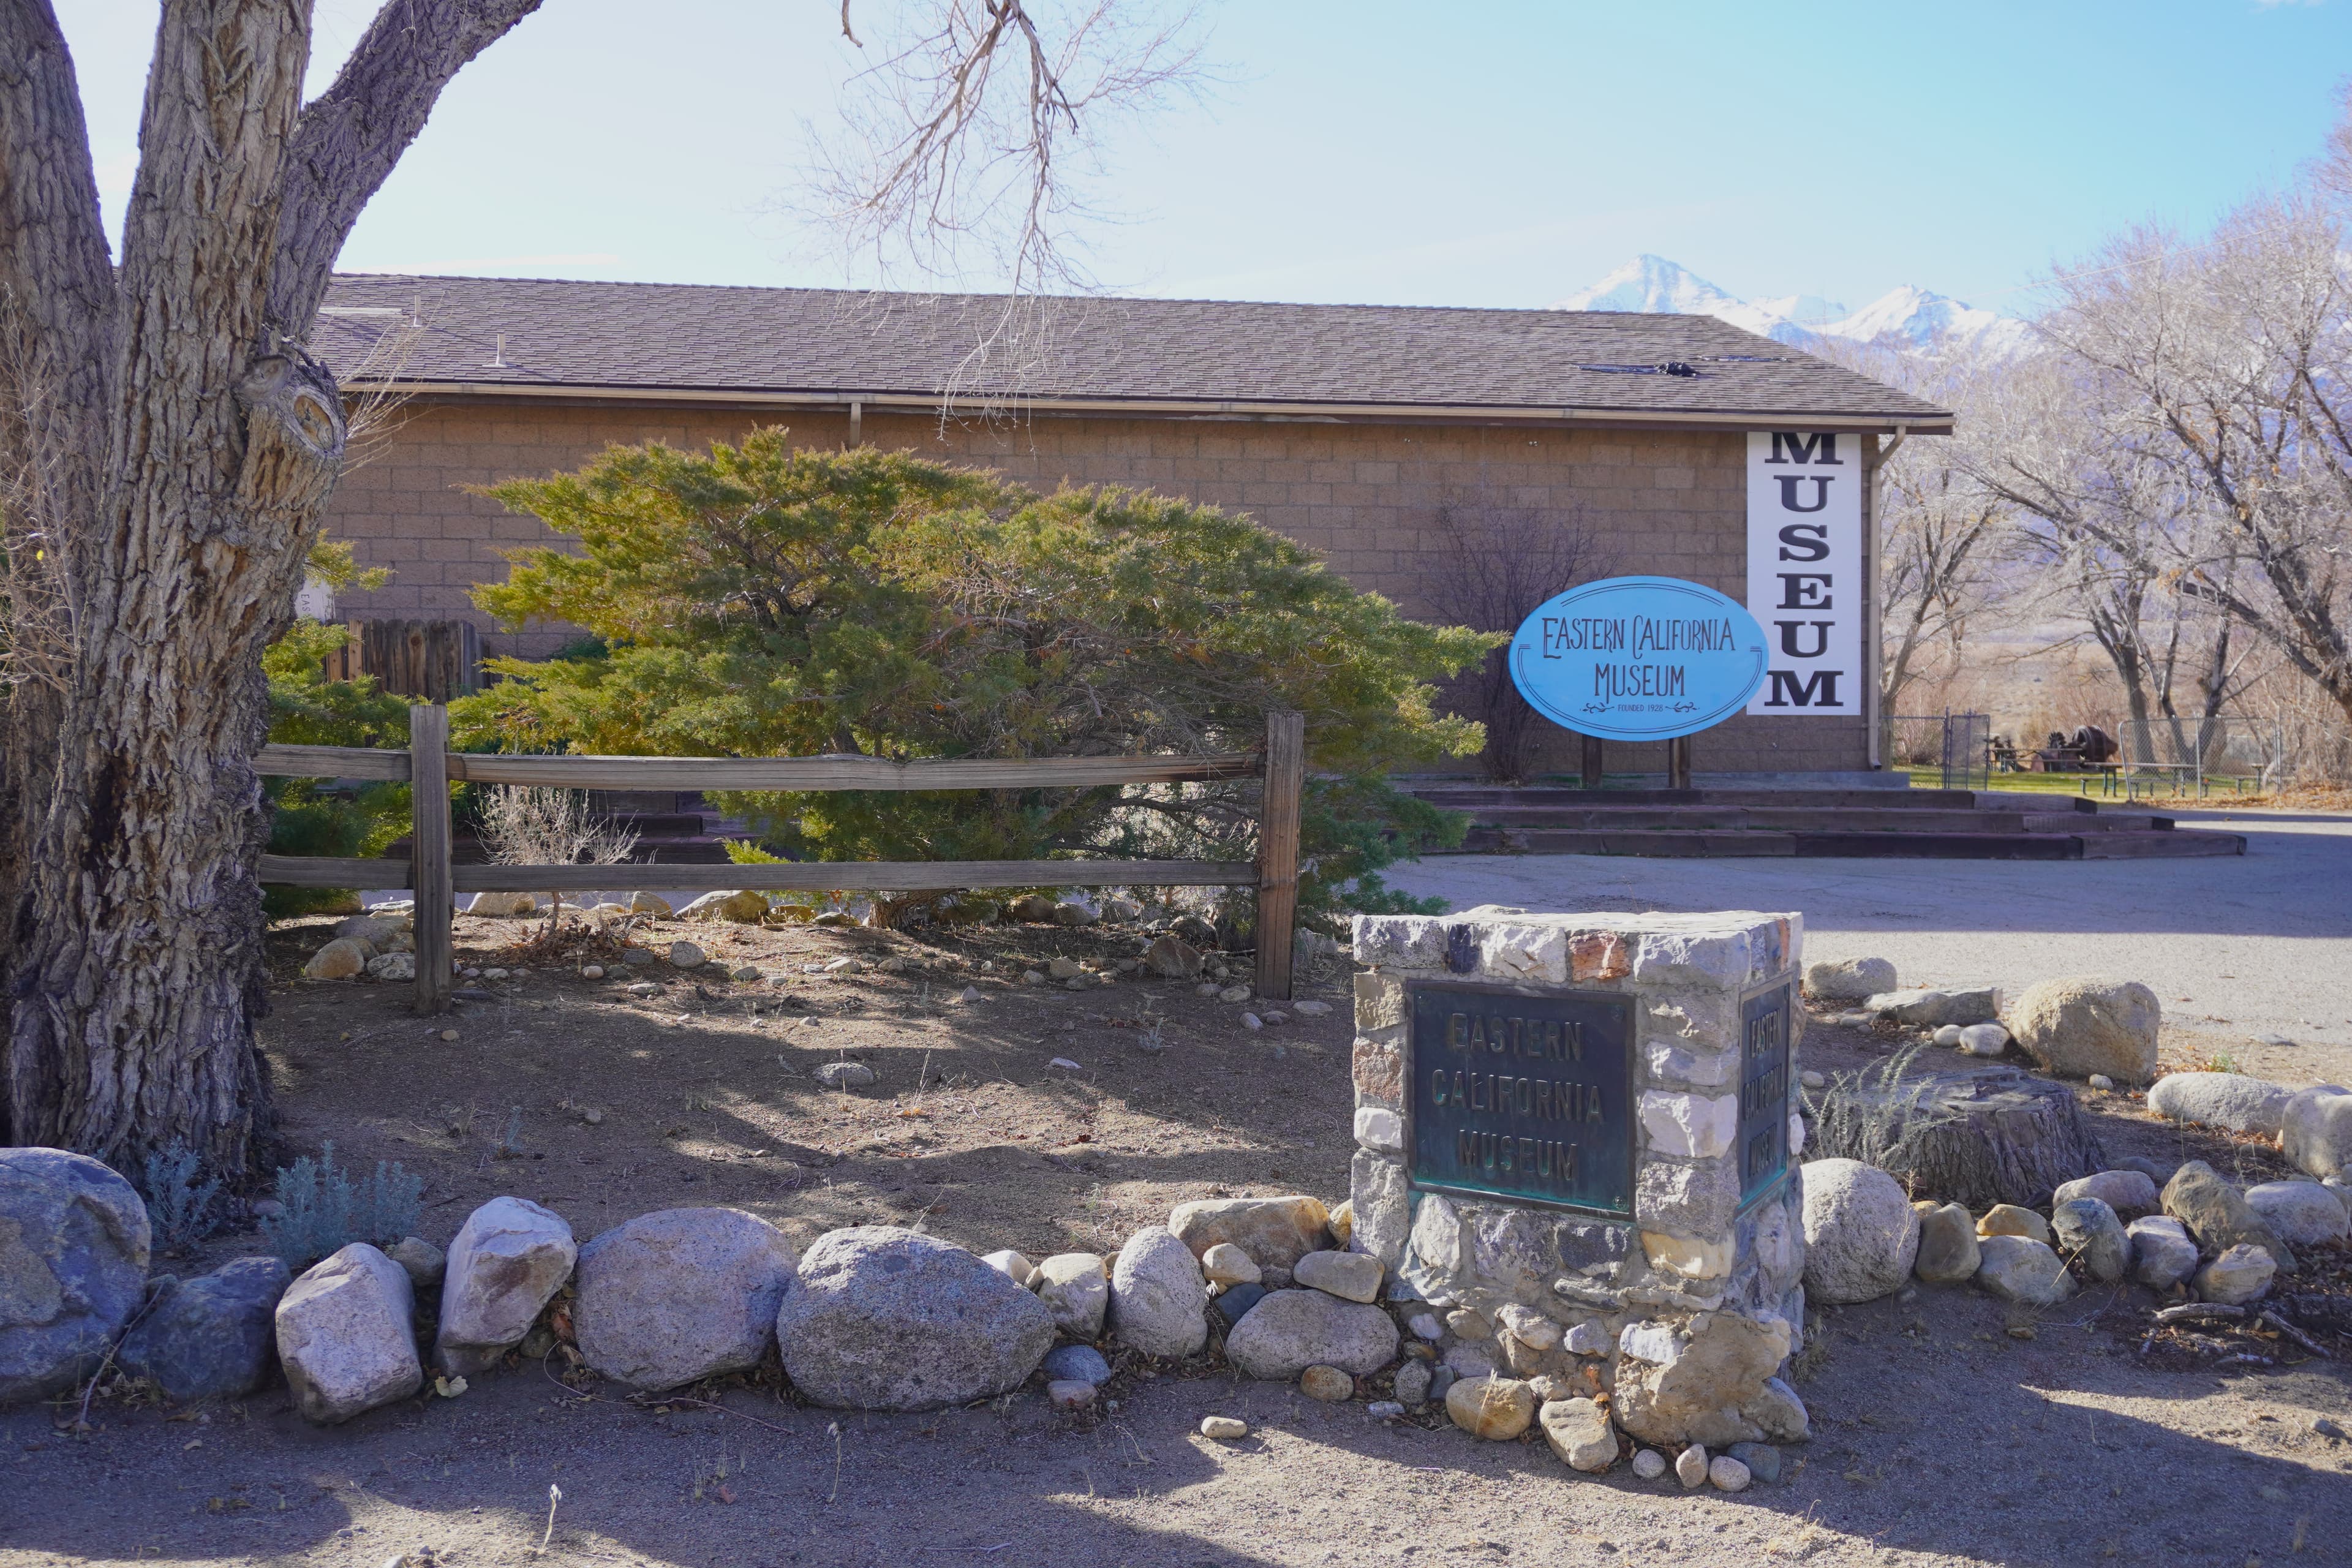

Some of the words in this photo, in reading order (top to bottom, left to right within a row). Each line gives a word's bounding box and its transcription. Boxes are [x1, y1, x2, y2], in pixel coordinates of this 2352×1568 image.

[1765, 433, 1844, 706] MUSEUM
[1542, 617, 1625, 659] EASTERN
[1632, 615, 1736, 660] CALIFORNIA
[1594, 663, 1685, 704] MUSEUM
[1452, 1013, 1583, 1061] EASTERN
[1751, 1008, 1782, 1058] EASTERN
[1431, 1069, 1605, 1125] CALIFORNIA
[1458, 1129, 1578, 1181] MUSEUM
